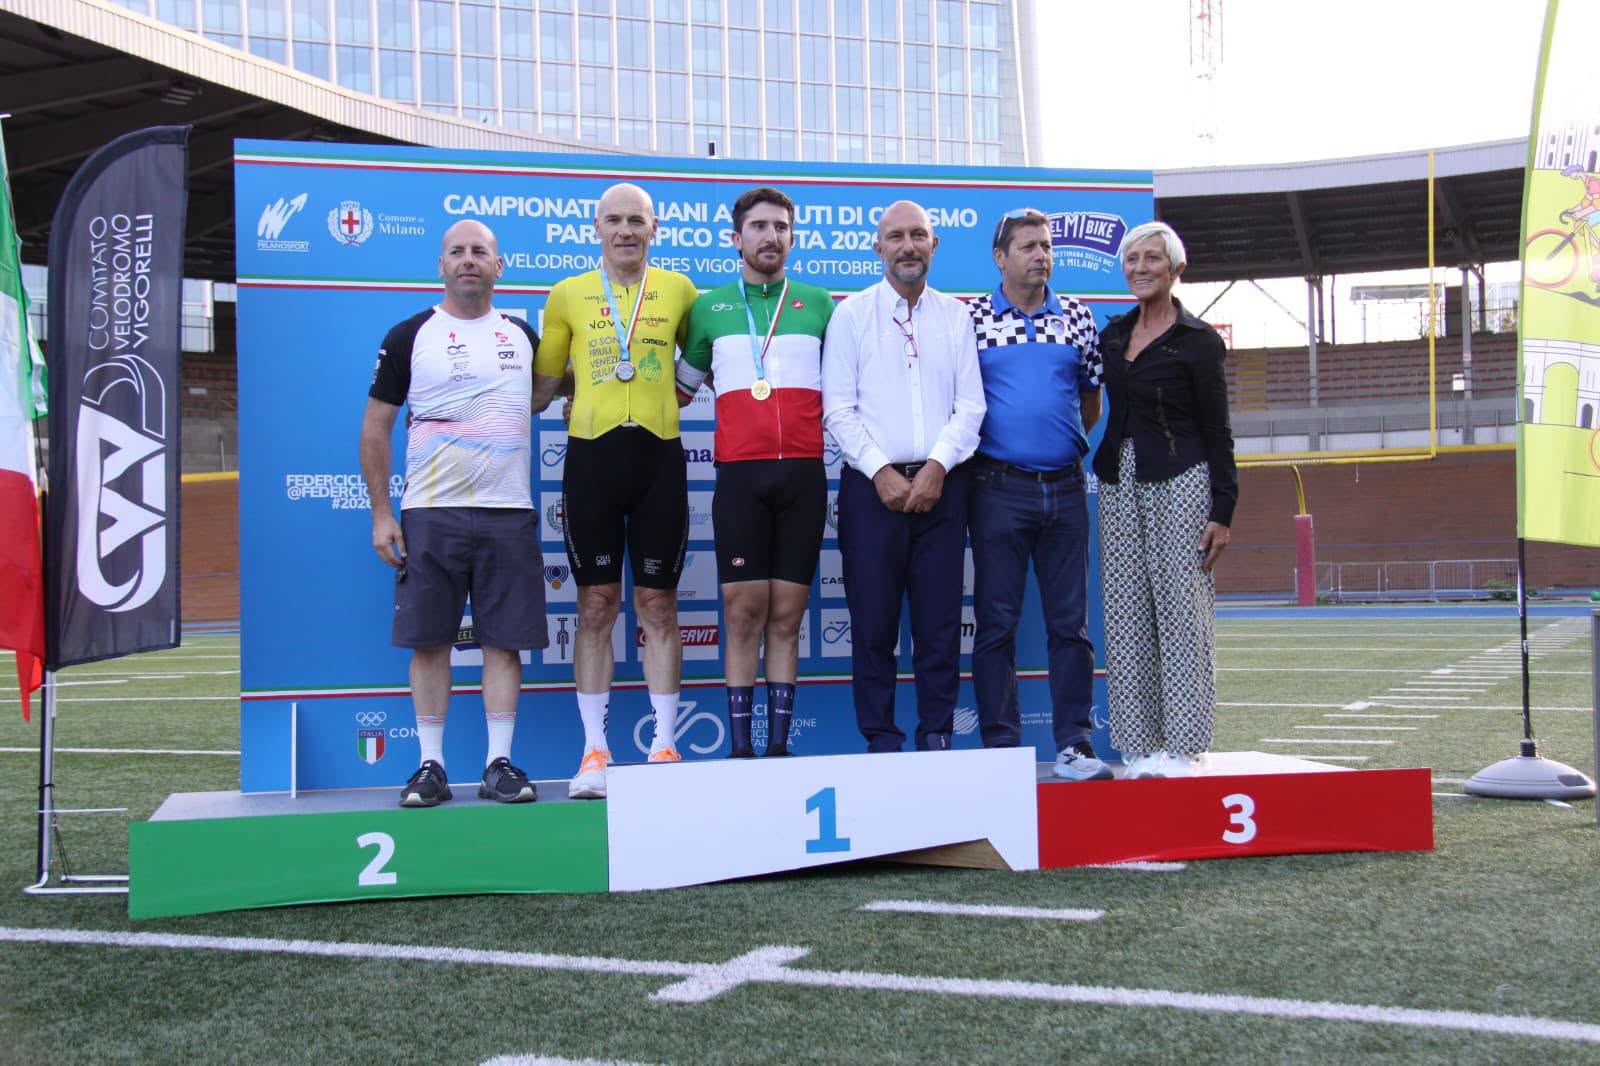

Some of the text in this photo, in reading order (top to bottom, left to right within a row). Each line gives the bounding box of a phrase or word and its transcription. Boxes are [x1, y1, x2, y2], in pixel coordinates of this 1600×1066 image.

[378, 213, 417, 223] Comune
[653, 201, 708, 223] IANI
[838, 205, 863, 226] DI
[379, 222, 425, 235] Milano
[546, 223, 713, 248] PARPICO
[1085, 219, 1117, 238] BIKE
[257, 241, 309, 250] MILANOSPORT
[503, 253, 604, 270] VELODROM
[793, 259, 803, 274] 4
[807, 259, 882, 275] OTTOBRE
[89, 216, 110, 350] COMITATO
[111, 213, 132, 350] VELODROMO
[132, 214, 153, 349] VIGORELLI
[680, 628, 718, 643] ERVIT
[389, 727, 419, 738] CON
[806, 787, 851, 854] 1
[1222, 793, 1257, 844] 3
[356, 832, 397, 886] 2
